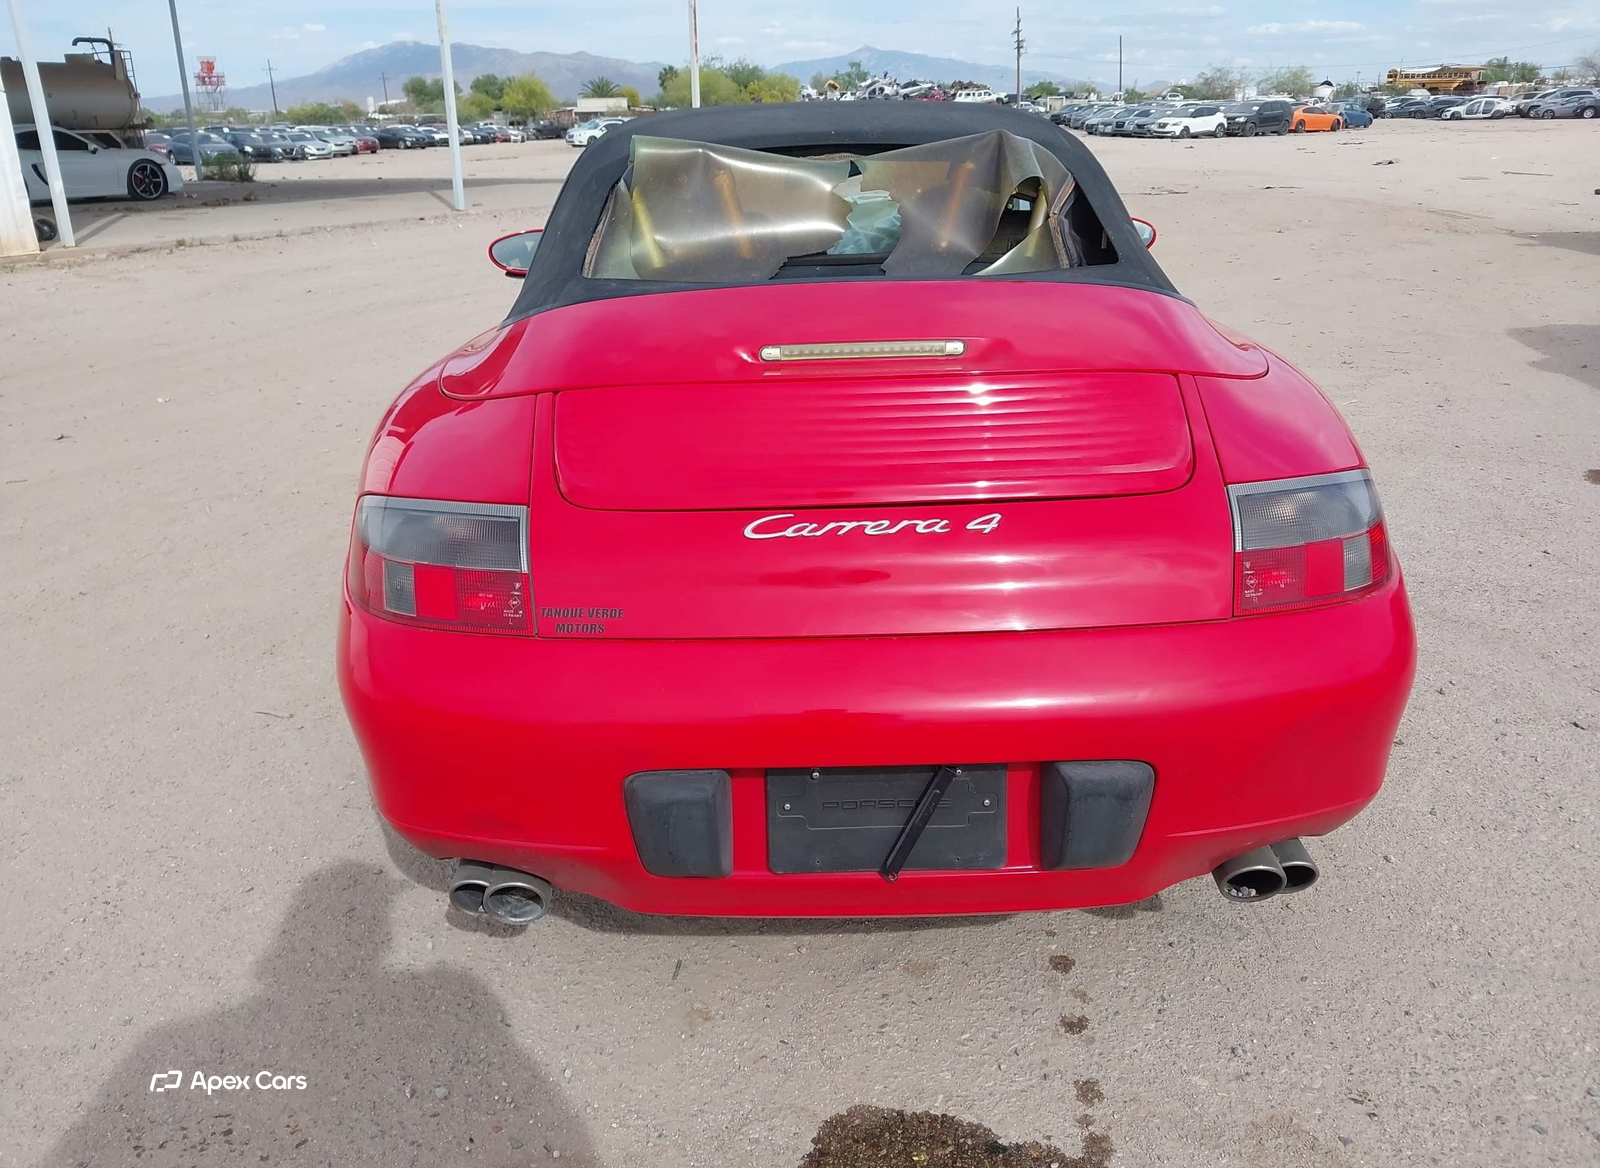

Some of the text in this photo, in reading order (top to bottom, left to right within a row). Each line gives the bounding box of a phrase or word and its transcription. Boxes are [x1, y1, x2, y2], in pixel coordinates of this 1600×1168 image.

[743, 512, 1001, 540] Carrera 4
[541, 607, 624, 619] TANQUE VERDE
[555, 623, 605, 634] MOTORS
[822, 798, 952, 811] PORSCE
